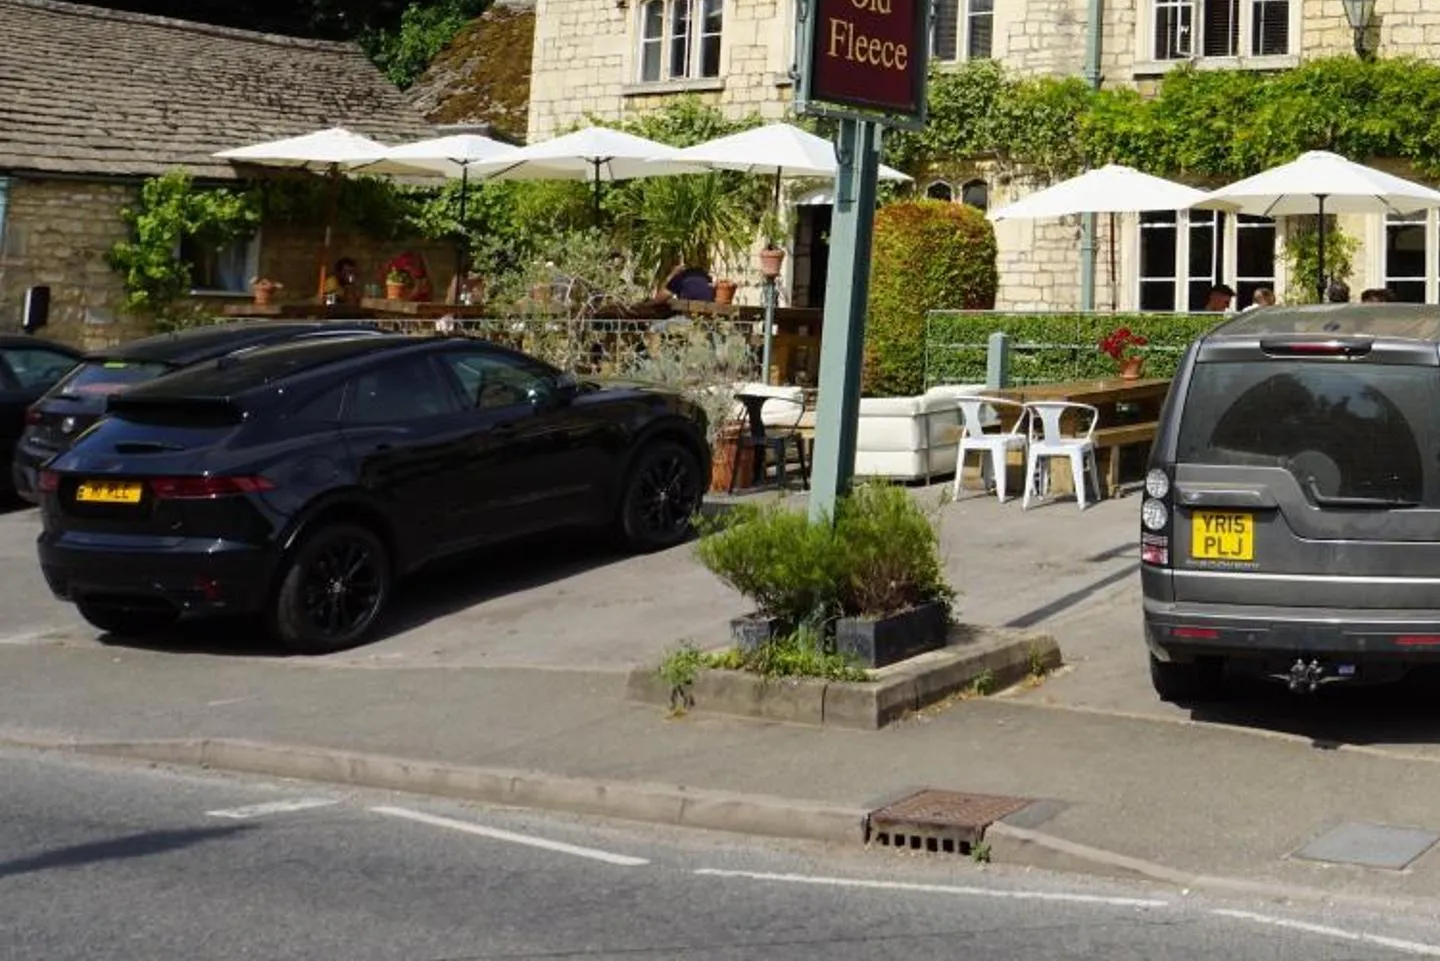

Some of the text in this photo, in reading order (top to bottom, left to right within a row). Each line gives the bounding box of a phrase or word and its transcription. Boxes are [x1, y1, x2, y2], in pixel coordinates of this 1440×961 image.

[828, 19, 907, 70] Fleece
[1202, 515, 1245, 533] YR15
[1204, 537, 1243, 556] PLJ
